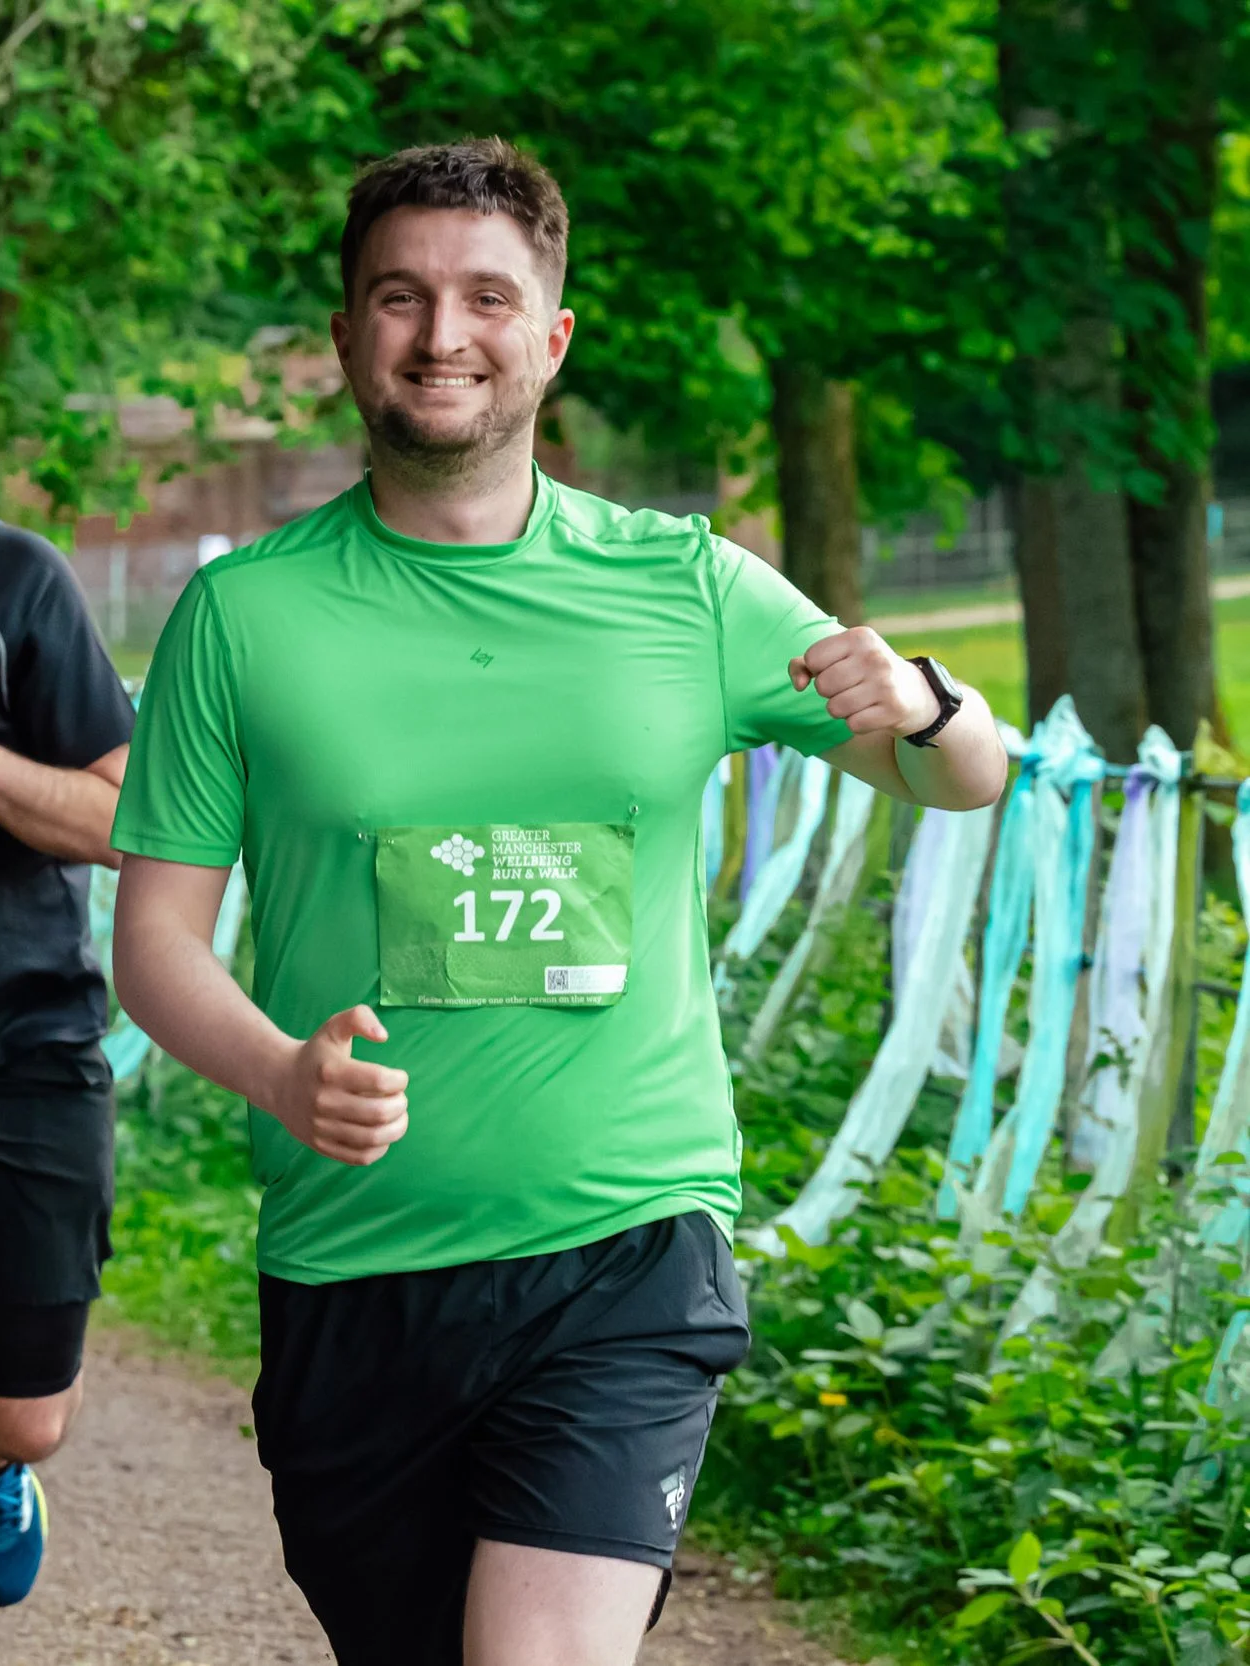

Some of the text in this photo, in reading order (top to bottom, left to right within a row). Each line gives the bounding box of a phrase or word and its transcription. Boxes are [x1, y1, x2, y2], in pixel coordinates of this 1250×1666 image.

[492, 830, 550, 842] GREATER
[492, 842, 582, 855] MANCHESTER
[493, 855, 572, 867] WELLBEING
[492, 867, 578, 880] RUN & WALK
[453, 889, 564, 942] 172
